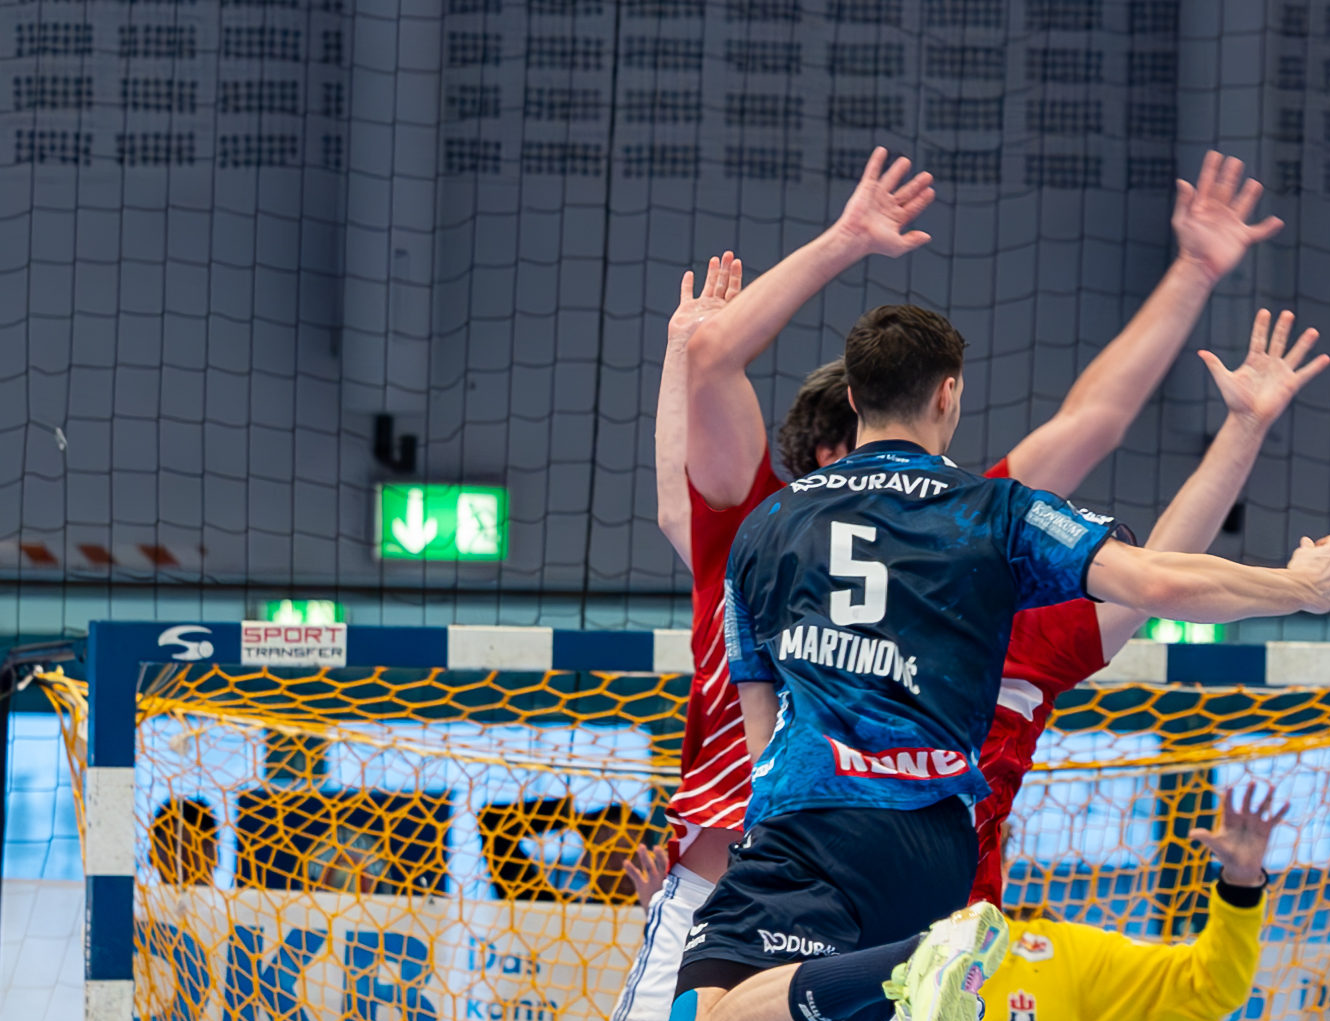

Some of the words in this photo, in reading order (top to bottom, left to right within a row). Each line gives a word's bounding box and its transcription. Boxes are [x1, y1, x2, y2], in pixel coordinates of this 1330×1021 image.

[826, 472, 949, 498] DURAVIT
[829, 520, 889, 626] 5
[243, 627, 343, 644] SPORT
[243, 647, 343, 659] TRANSFER
